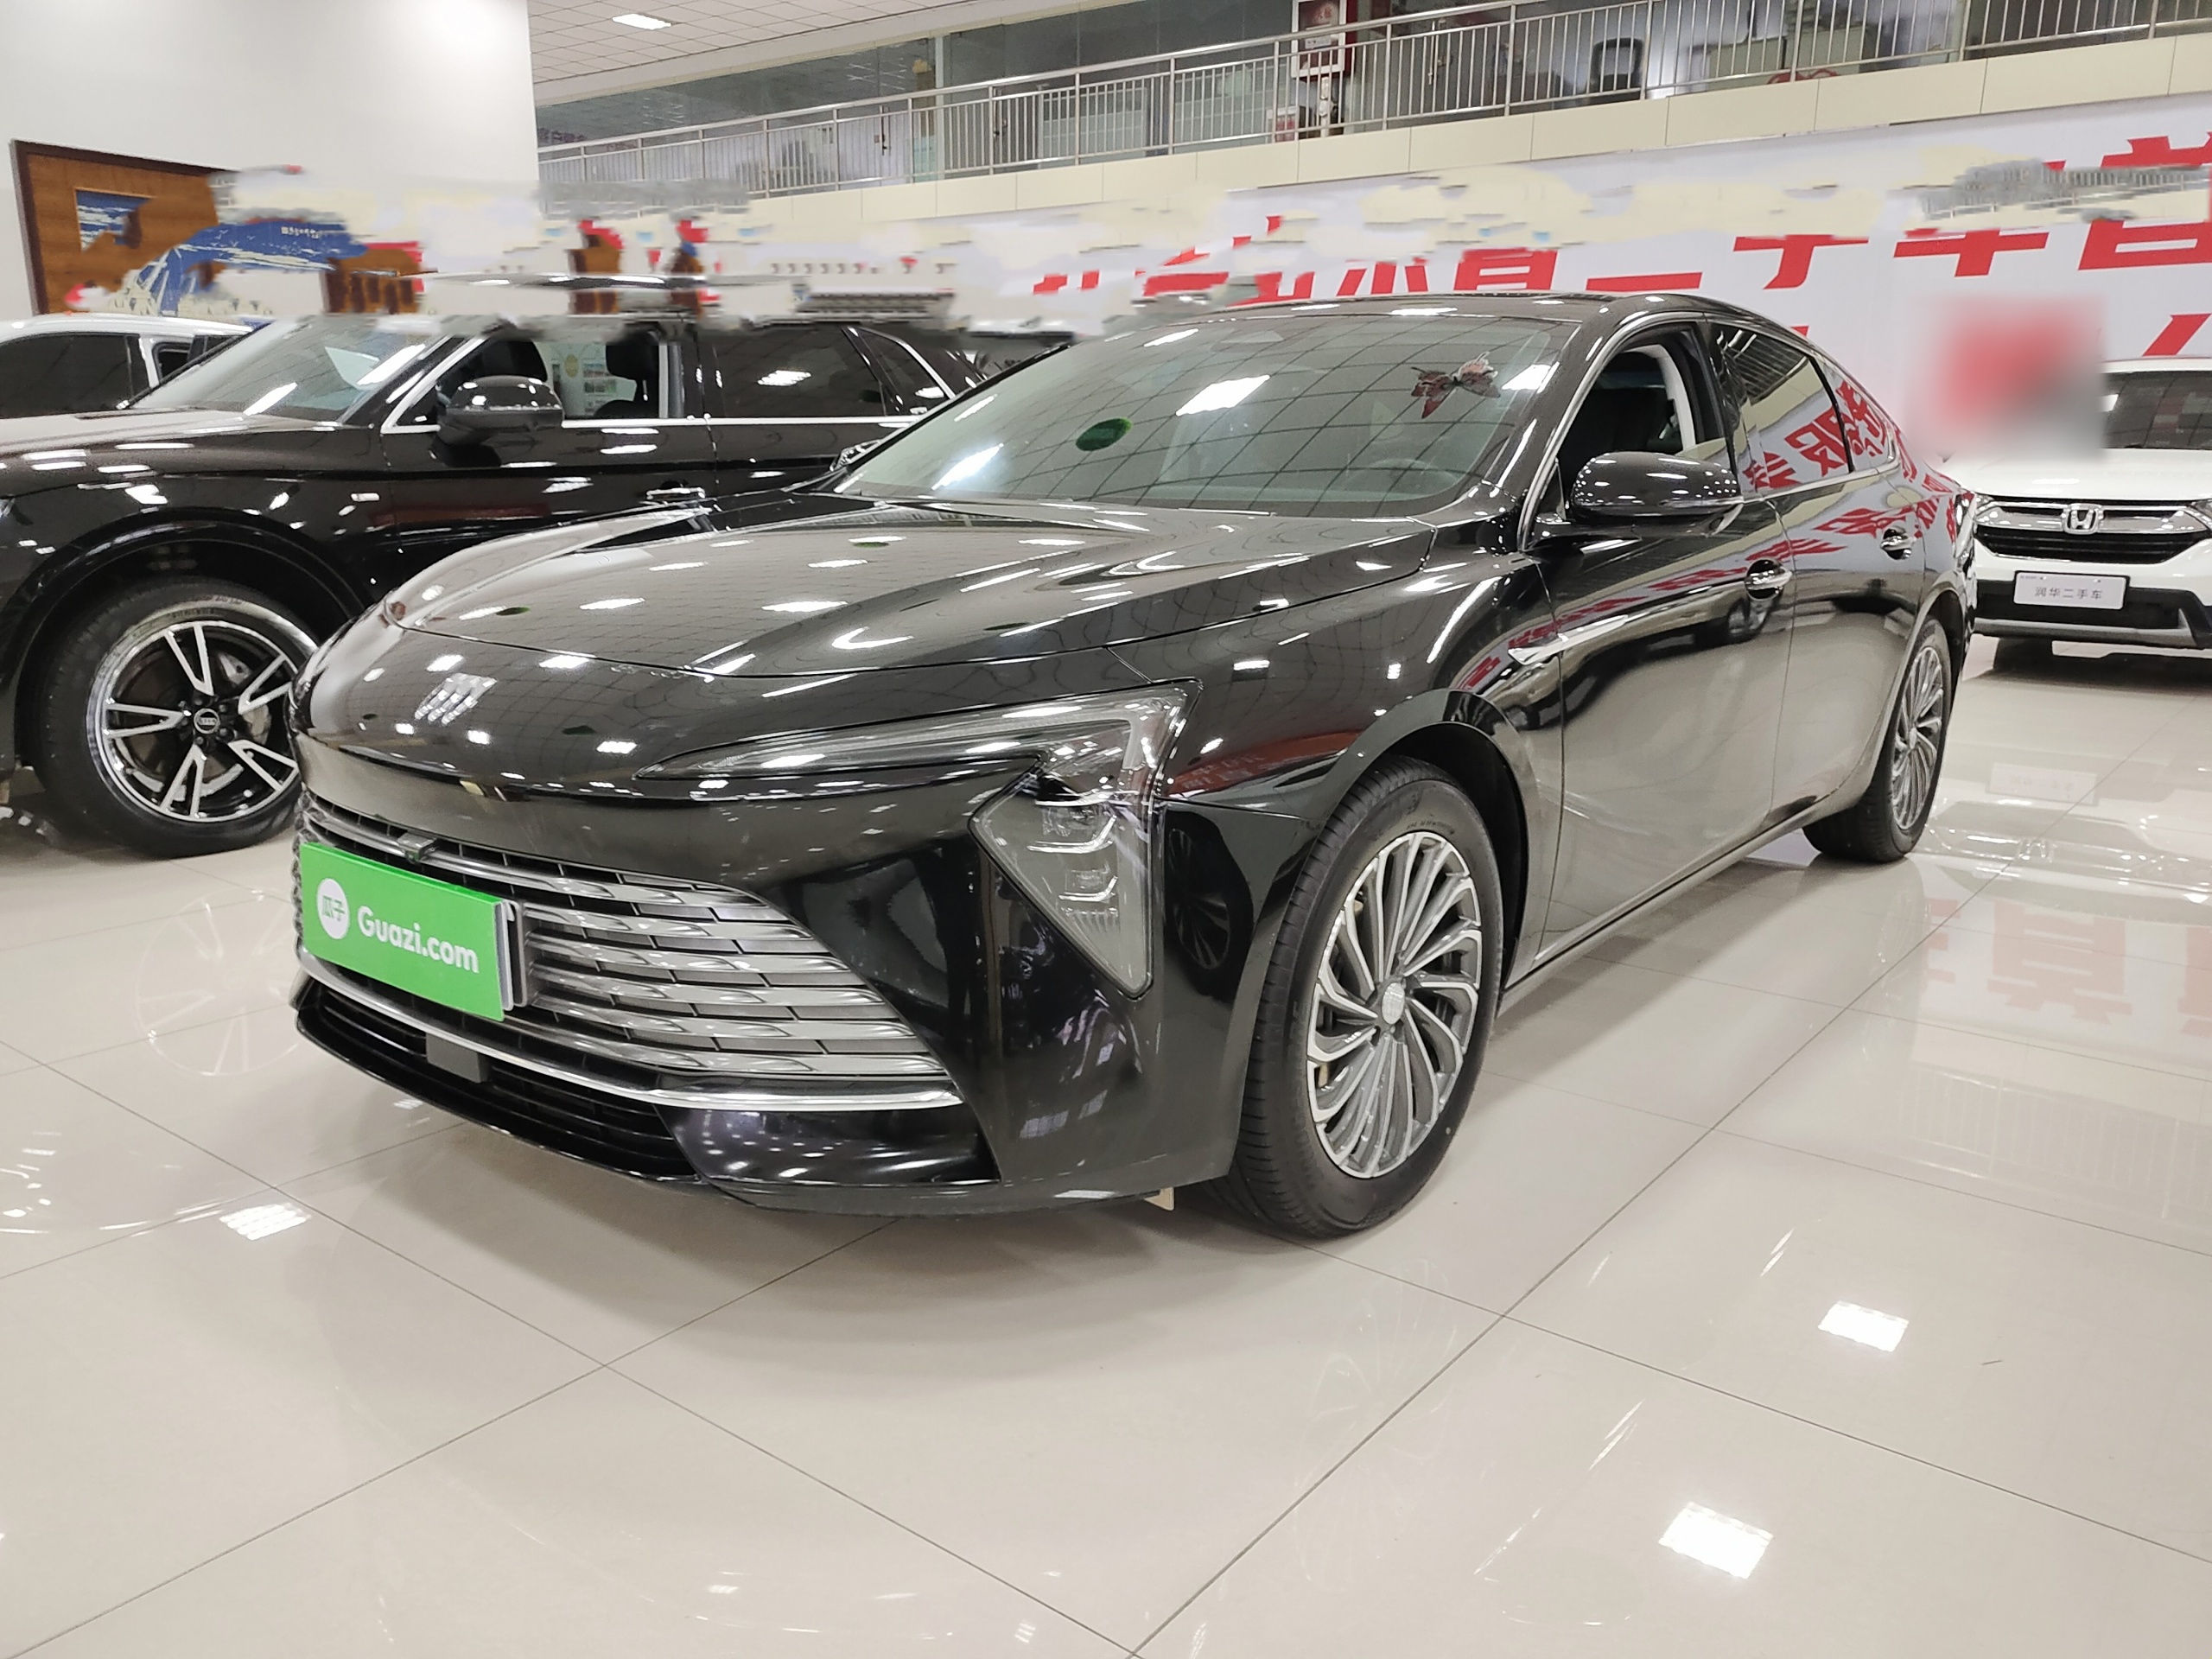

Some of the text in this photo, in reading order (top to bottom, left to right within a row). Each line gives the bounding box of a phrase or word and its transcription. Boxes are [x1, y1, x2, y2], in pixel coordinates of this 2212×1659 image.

[2035, 586, 2103, 600] 润华二手车
[357, 905, 480, 974] Guazi.com
